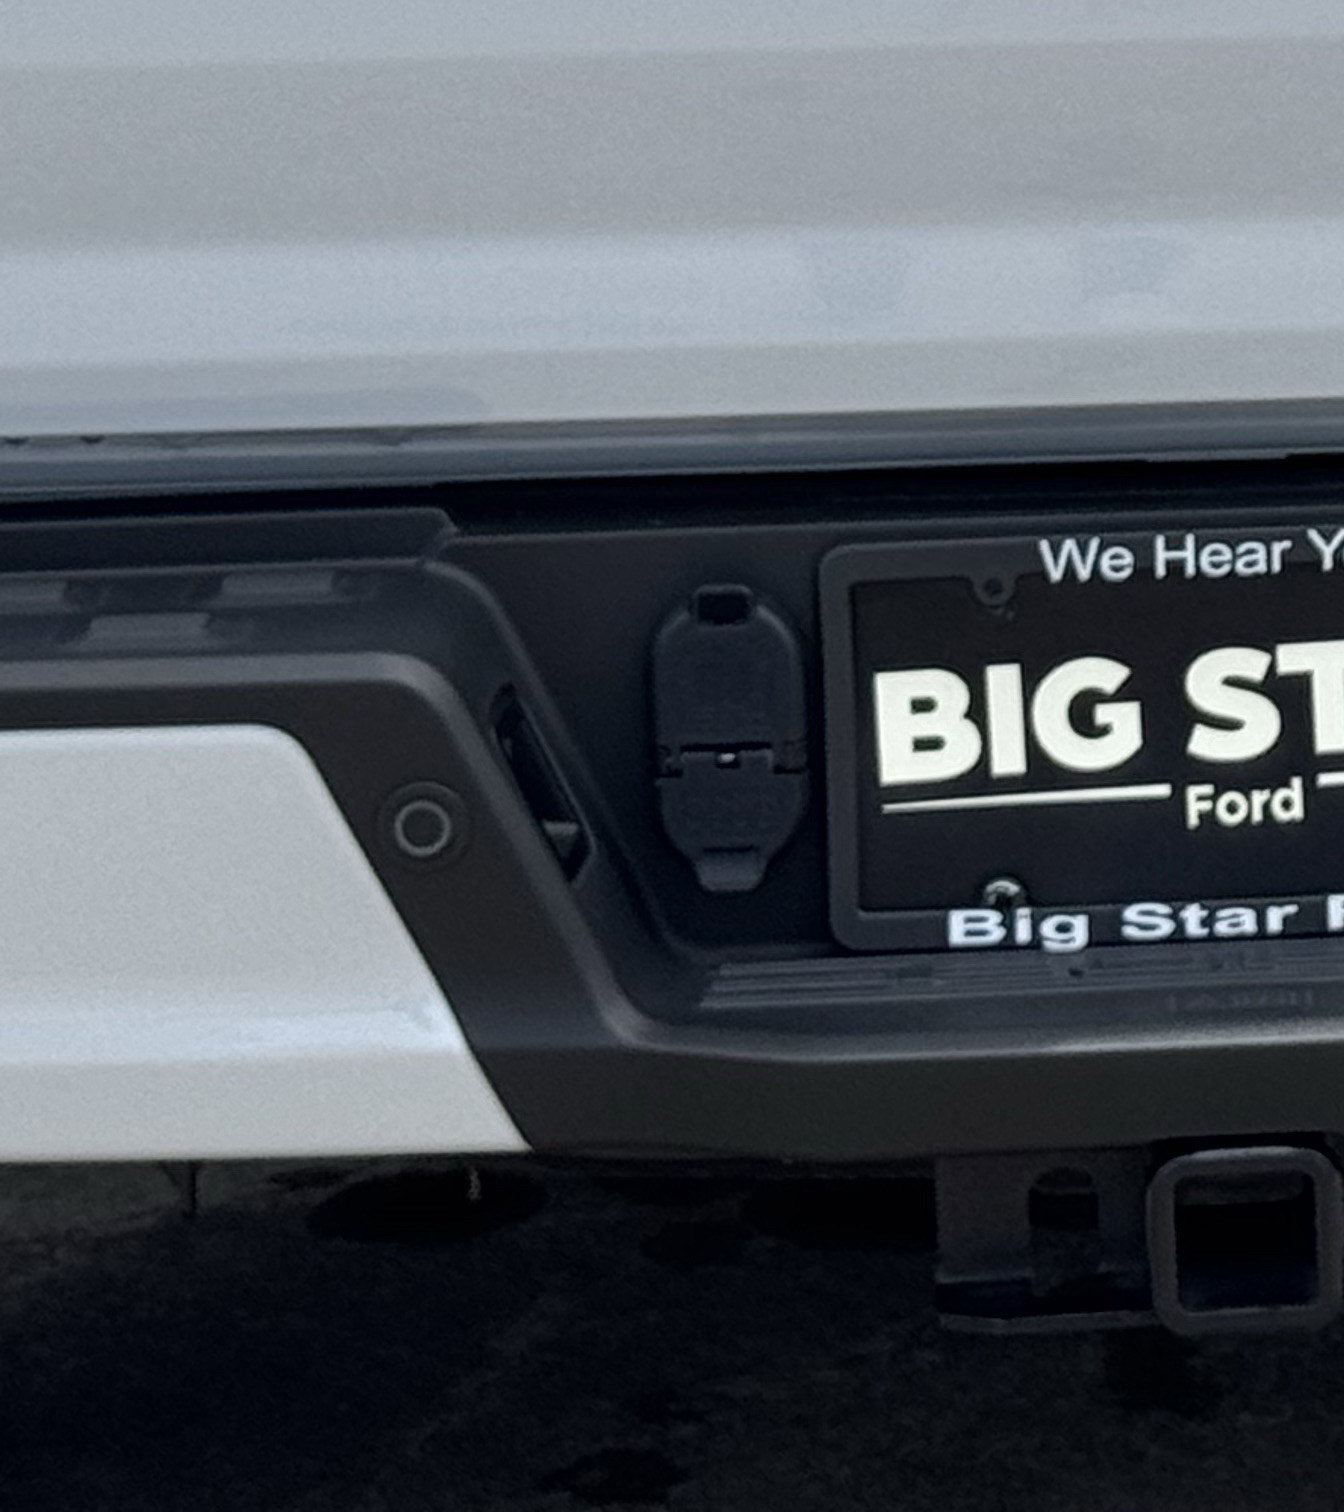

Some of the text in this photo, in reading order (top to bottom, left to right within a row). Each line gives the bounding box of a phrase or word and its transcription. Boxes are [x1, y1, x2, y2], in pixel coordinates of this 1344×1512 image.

[1038, 535, 1135, 583] We
[1154, 532, 1293, 579] Hear
[872, 656, 1144, 787] BIG
[1185, 775, 1305, 830] Ford
[947, 907, 1090, 954] Big
[1120, 899, 1291, 941] Star
